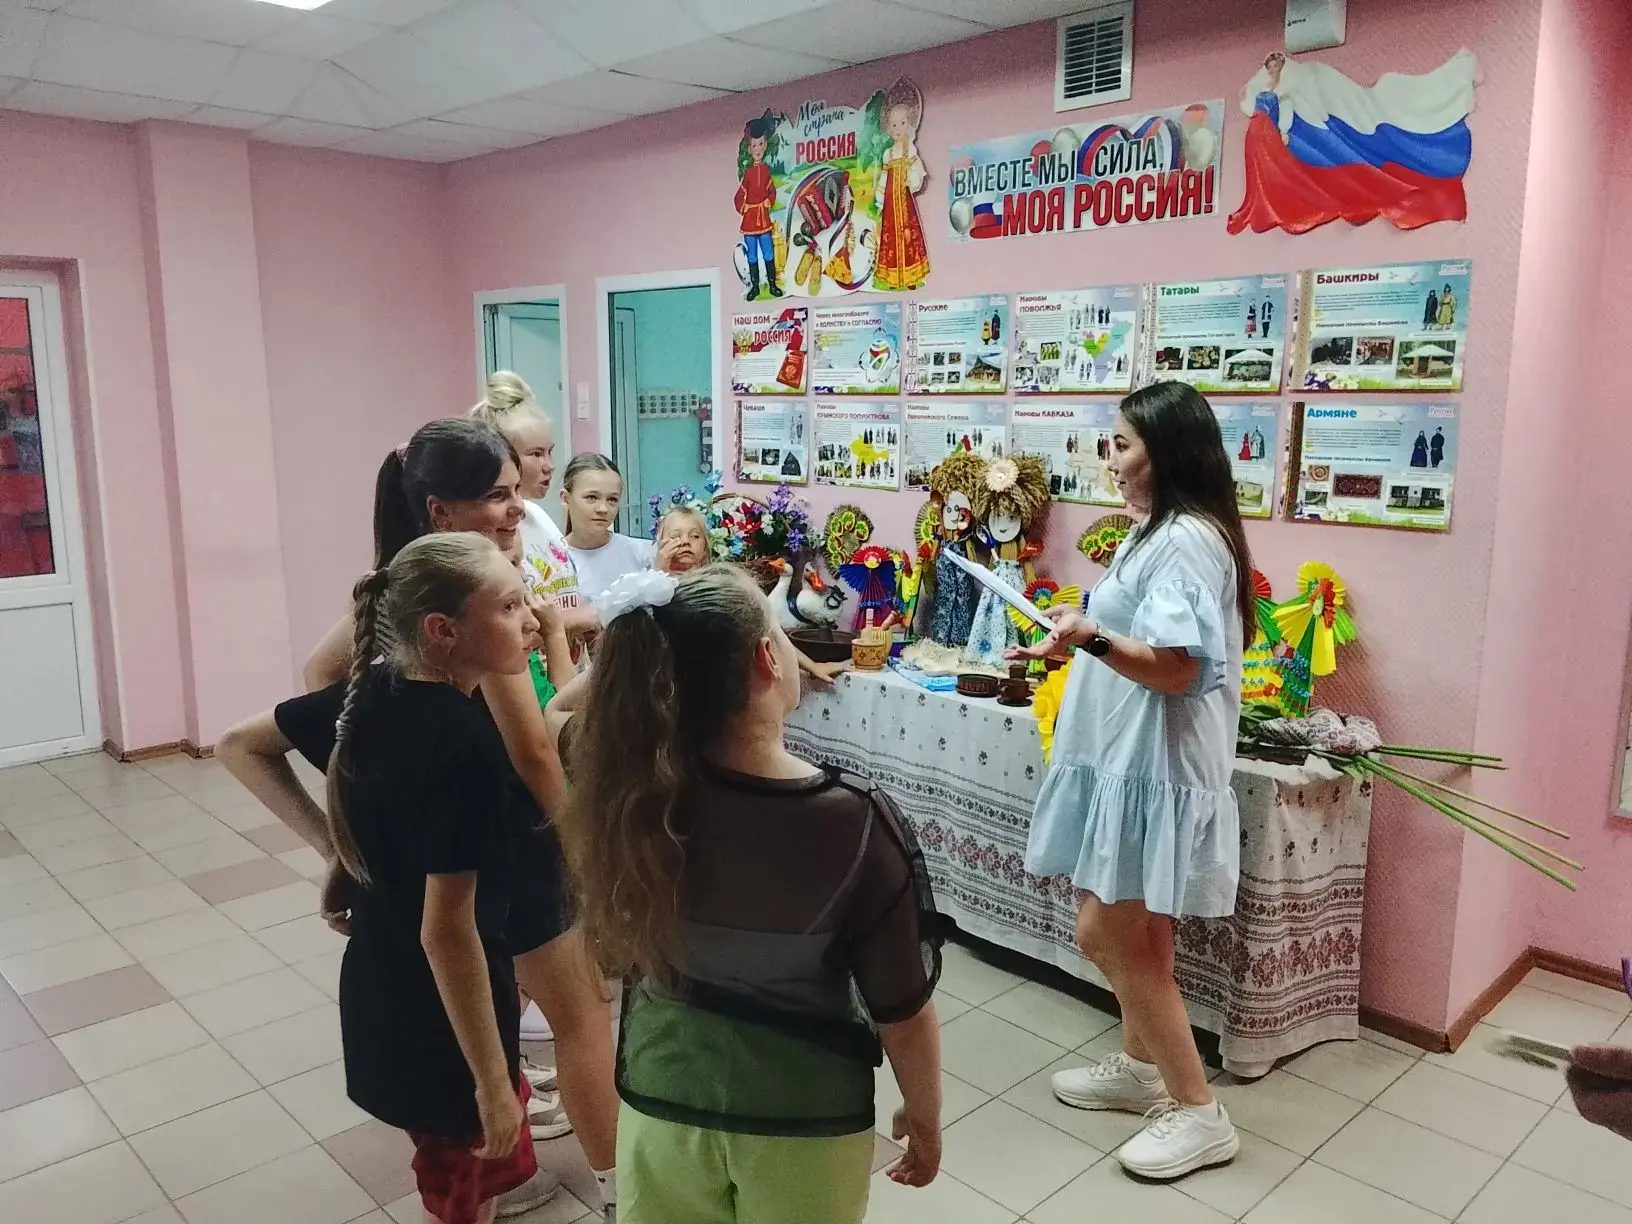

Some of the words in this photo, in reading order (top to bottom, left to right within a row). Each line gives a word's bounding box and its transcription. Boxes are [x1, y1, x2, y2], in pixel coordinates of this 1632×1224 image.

[796, 101, 825, 129] Моя
[803, 110, 845, 137] страна
[795, 130, 856, 166] РОССИЯ
[954, 157, 1033, 197] ВМЕСТЕ
[1038, 149, 1077, 187] МЫ
[1094, 136, 1165, 178] СИЛА,
[1002, 185, 1065, 237] МОЯ
[1072, 164, 1215, 229] РОССИЯ!
[1316, 273, 1380, 285] Башкиры
[1160, 286, 1200, 297] Татары
[1019, 295, 1048, 303] Народы
[918, 304, 949, 312] Русские
[753, 329, 792, 346] РОССИЯ
[1041, 410, 1075, 418] КАВКАЗА
[1306, 407, 1358, 419] Армяне
